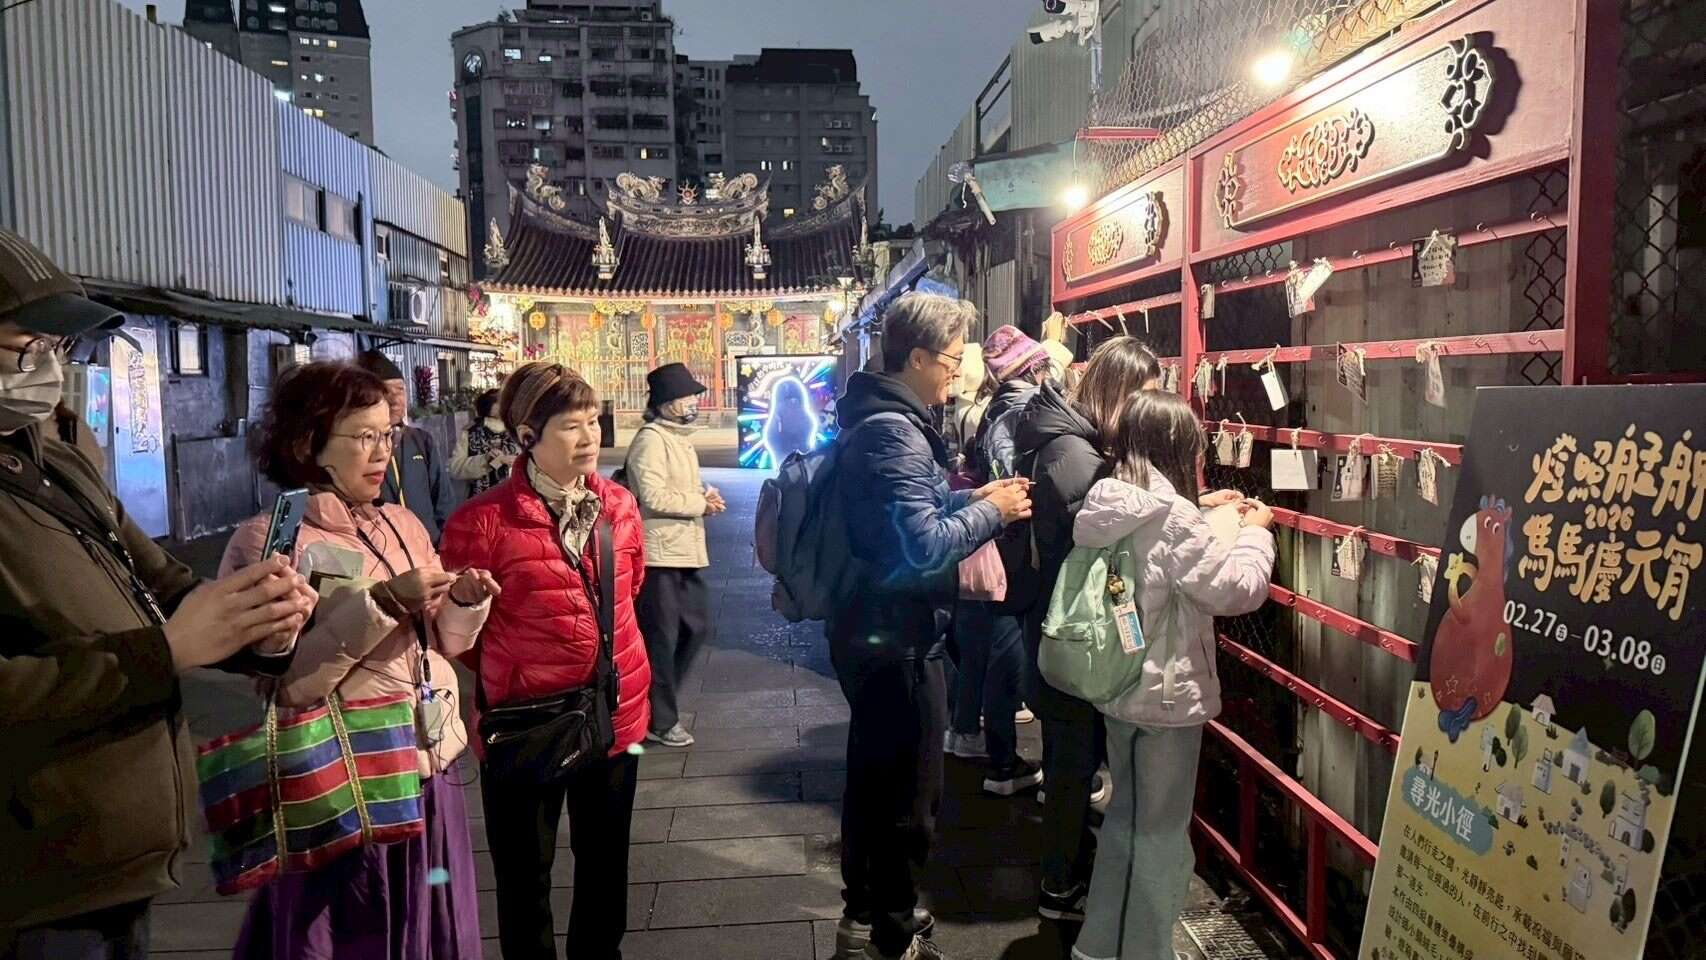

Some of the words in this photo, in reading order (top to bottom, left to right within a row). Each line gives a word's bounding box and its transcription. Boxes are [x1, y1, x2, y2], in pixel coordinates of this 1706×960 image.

[1585, 504, 1634, 531] 2026
[1519, 513, 1702, 621] 馬馬慶元宵
[1410, 775, 1475, 842] 尋光小徑
